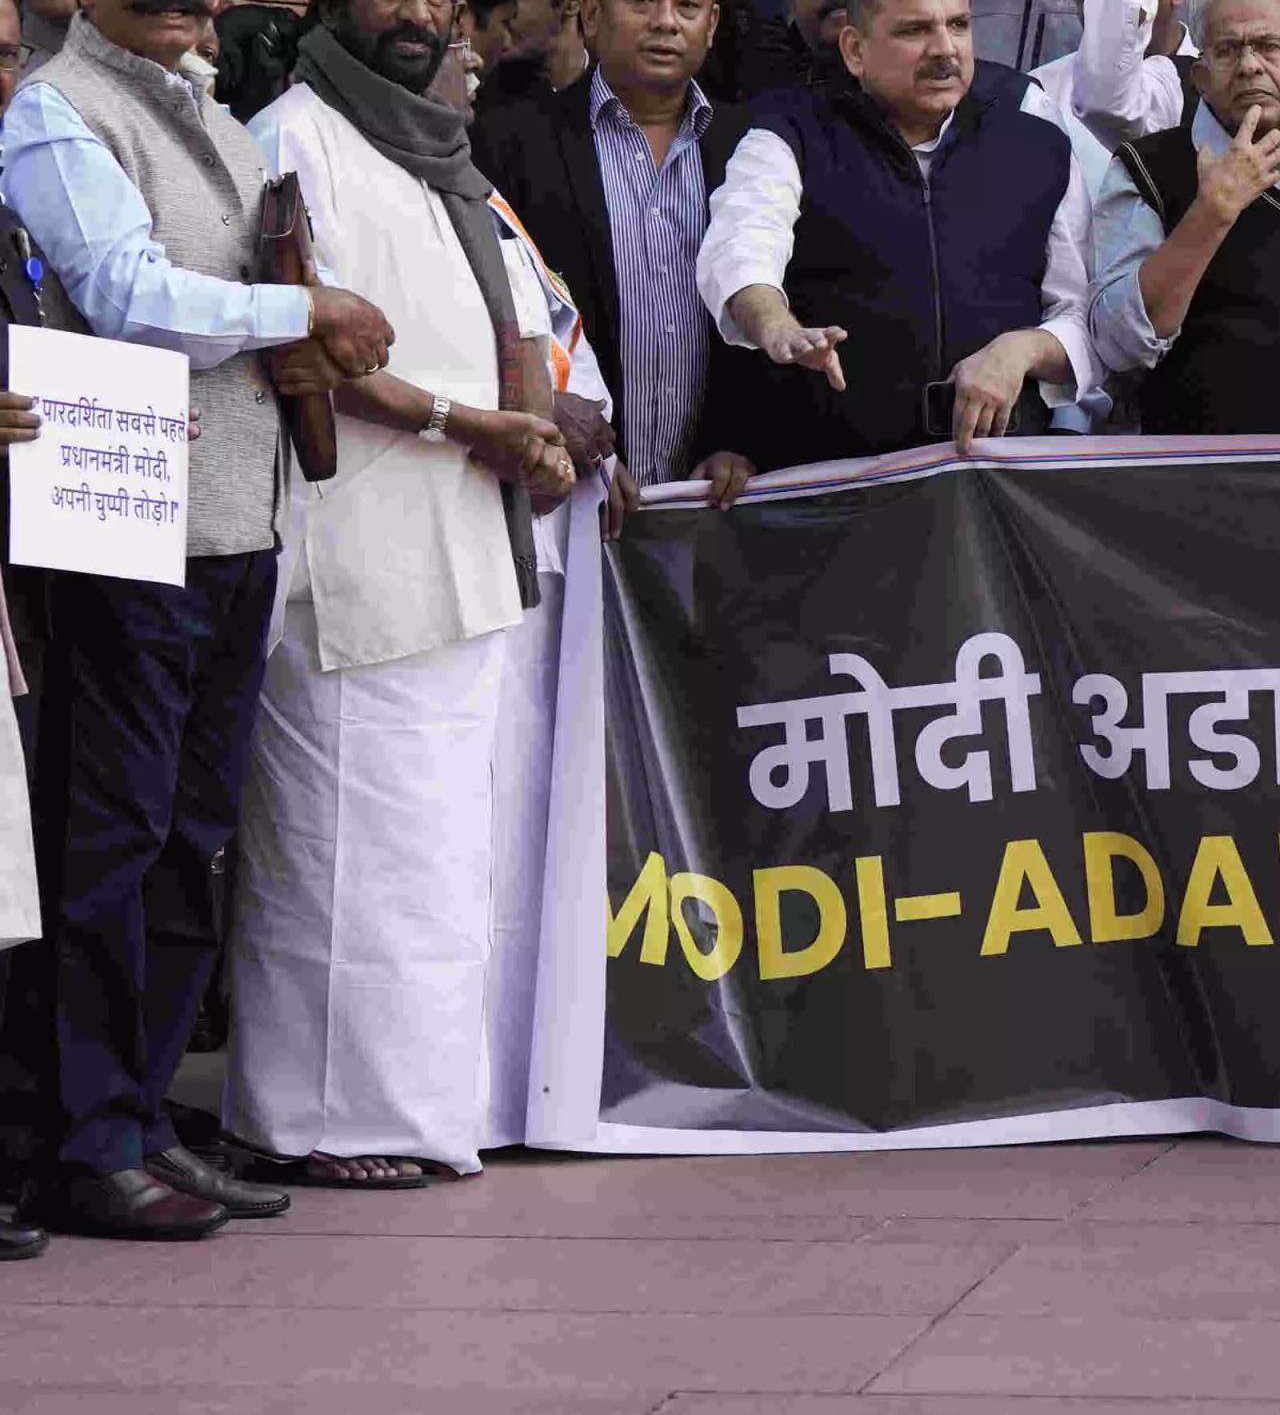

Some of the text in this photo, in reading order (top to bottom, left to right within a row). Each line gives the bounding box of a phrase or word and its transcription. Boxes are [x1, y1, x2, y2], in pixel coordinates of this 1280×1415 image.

[41, 397, 114, 430] पारदर्शिता
[116, 406, 156, 435] सबसे
[61, 444, 129, 476] प्रधानमंत्री
[50, 483, 92, 513] अपनी
[94, 487, 130, 521] चुप्पी
[736, 632, 1041, 812] मोदी
